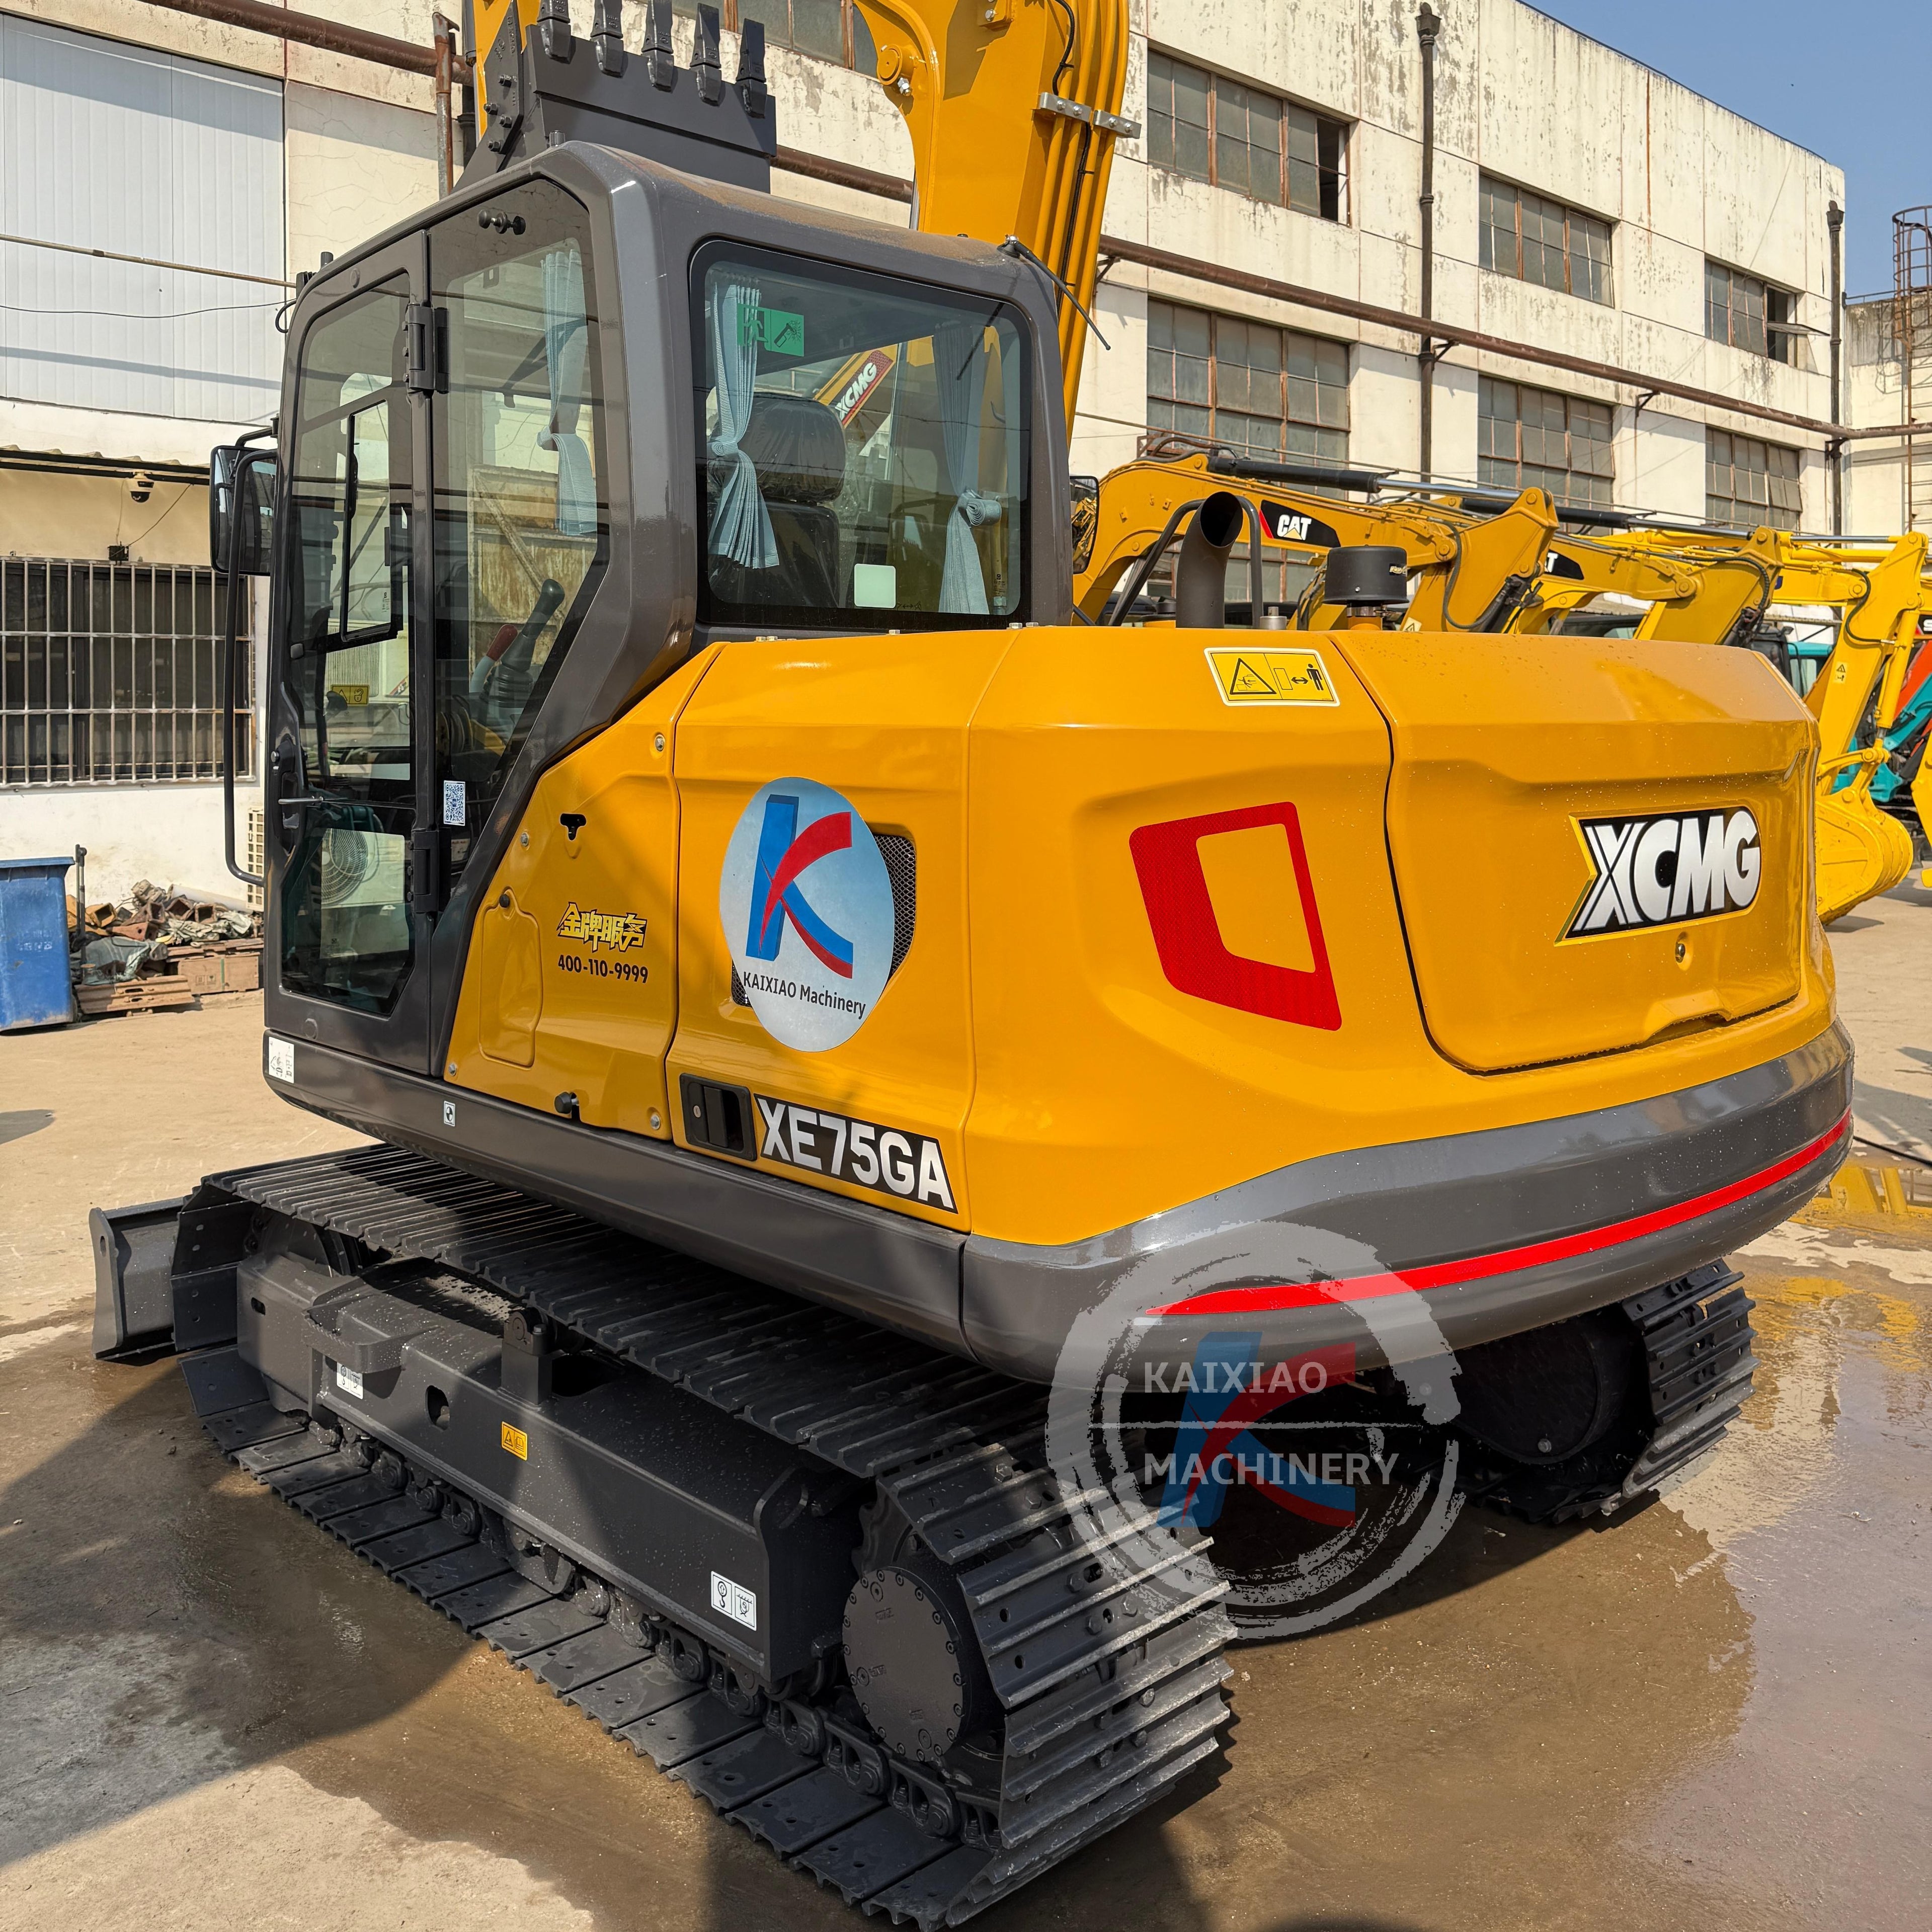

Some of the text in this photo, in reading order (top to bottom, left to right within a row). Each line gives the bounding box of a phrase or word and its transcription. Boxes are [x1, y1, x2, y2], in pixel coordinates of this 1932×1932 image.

[835, 362, 876, 421] XCMG
[1277, 514, 1312, 540] CAT
[1572, 811, 1760, 931] XCMG
[556, 902, 648, 953] 金牌服务
[558, 954, 649, 984] 400-110-9999
[743, 971, 866, 1020] KAIXIAO Machinery
[757, 1097, 954, 1210] XE75GA
